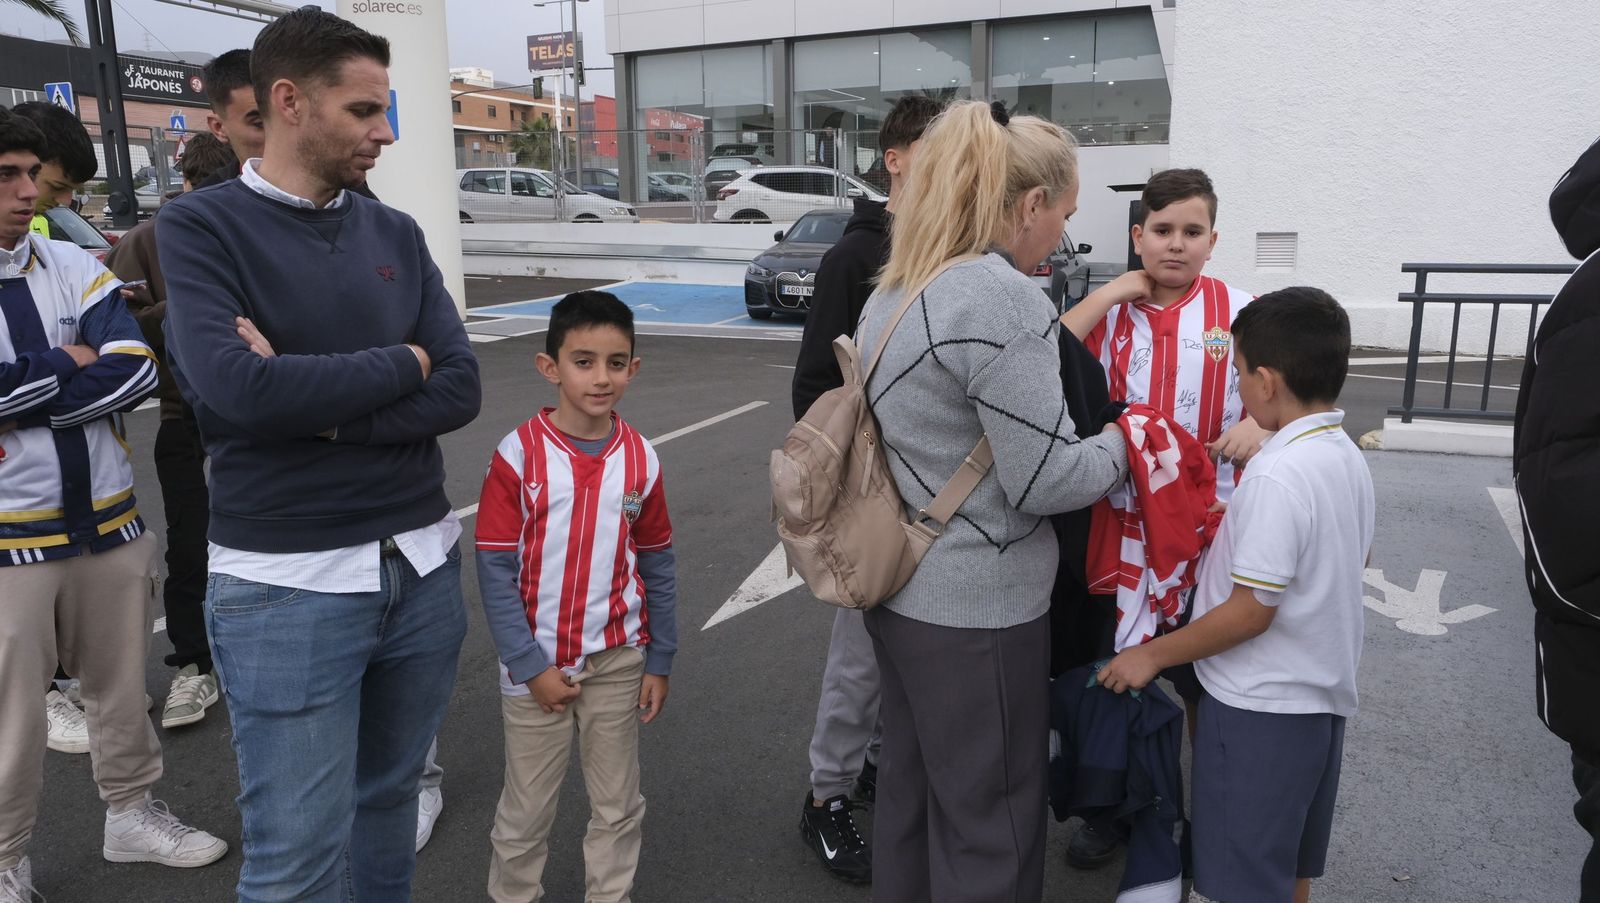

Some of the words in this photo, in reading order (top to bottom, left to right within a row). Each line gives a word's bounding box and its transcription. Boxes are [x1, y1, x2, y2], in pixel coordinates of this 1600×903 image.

[352, 0, 423, 16] solarec.es
[530, 43, 575, 61] TELAS
[128, 76, 183, 94] JAPONÉS
[786, 286, 804, 295] 4601
